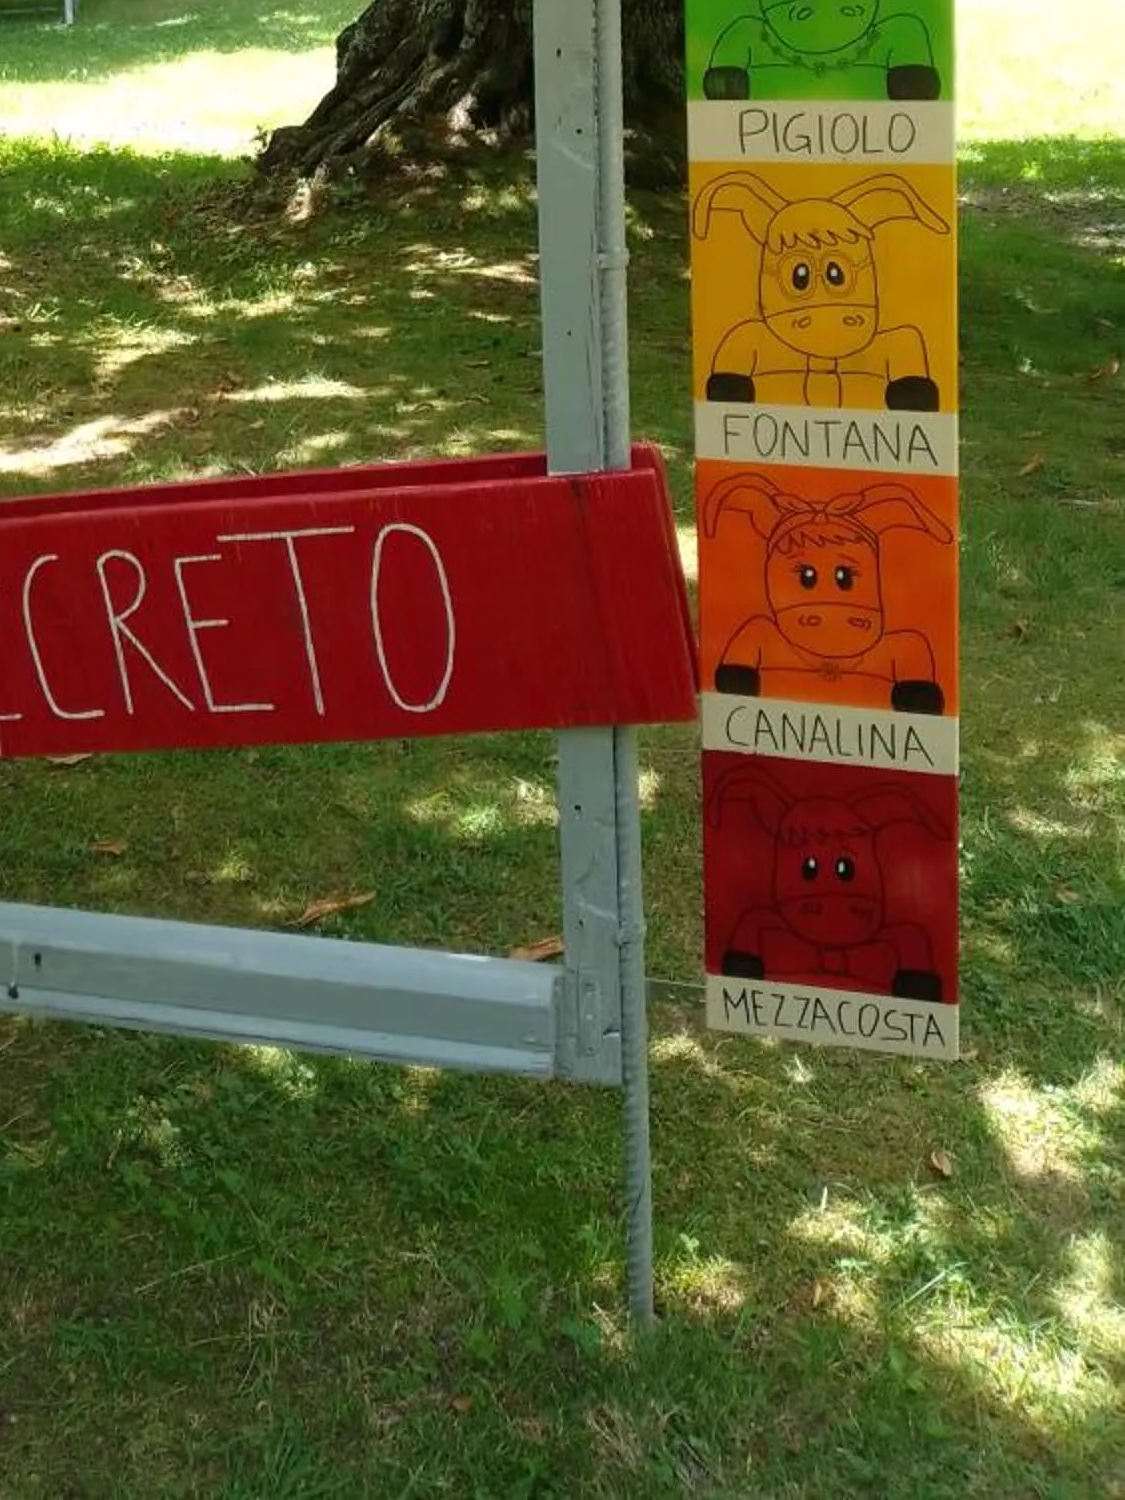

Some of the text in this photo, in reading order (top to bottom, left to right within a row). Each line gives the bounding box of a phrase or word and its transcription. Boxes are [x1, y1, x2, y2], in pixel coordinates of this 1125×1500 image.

[739, 108, 916, 156] PIGIOLO
[723, 417, 939, 466] FONTANA
[725, 704, 935, 768] CANALINA
[720, 986, 947, 1048] MEZZACOSTA
